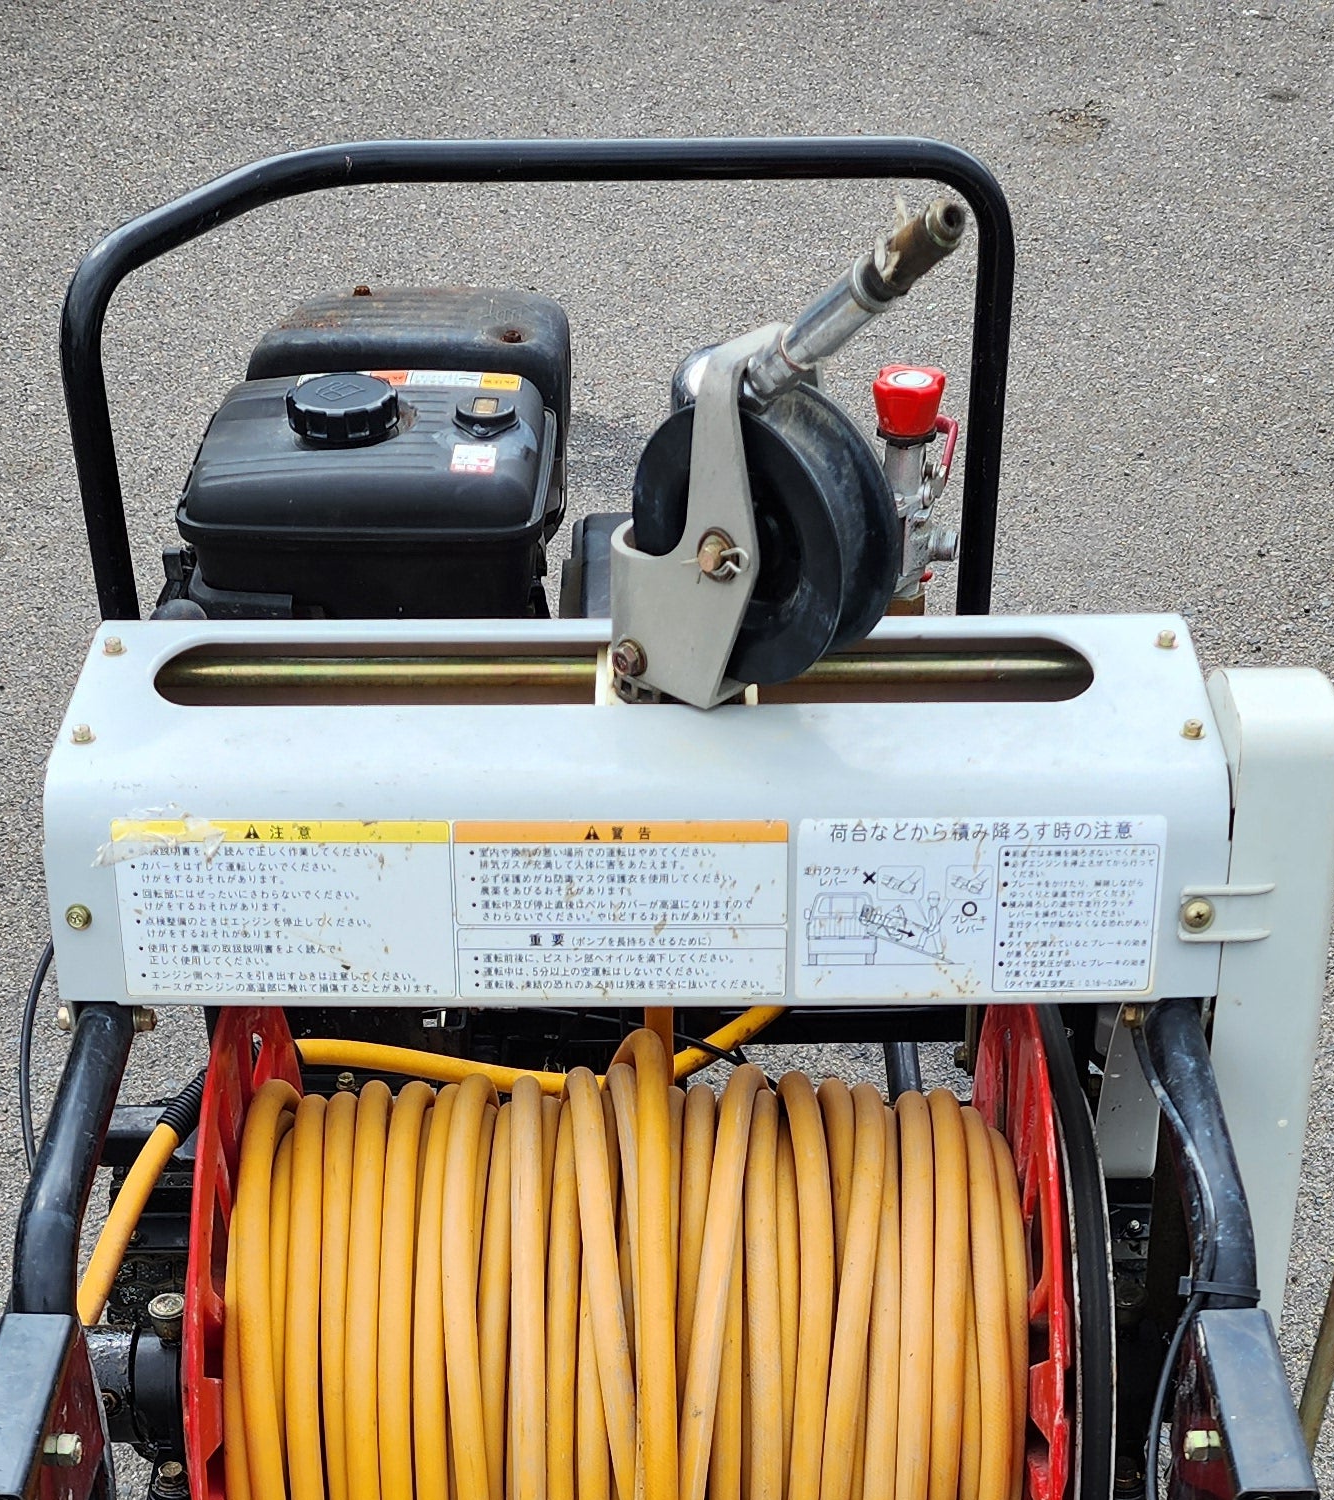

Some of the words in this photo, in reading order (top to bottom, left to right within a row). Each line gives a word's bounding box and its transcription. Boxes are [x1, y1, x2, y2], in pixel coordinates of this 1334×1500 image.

[270, 825, 311, 839] 注意
[612, 826, 651, 840] 警告
[830, 821, 1133, 842] 荷台などから積み降ろす時の注意
[140, 861, 338, 873] カバーをはずして運転しないでください。
[141, 874, 284, 885] けがをするおそれがあります。
[819, 877, 848, 887] レバー
[143, 889, 359, 900] 回転部にはぜったいにさわらないでください。
[144, 902, 286, 912] けがをするおそれがあります。
[145, 916, 372, 928] 点検整備のときはエンジンを停止してください。
[147, 929, 288, 940] けがをするおそれがあります。
[956, 925, 984, 934] レバー
[530, 934, 564, 946] 重要
[150, 955, 269, 966] 正しく使用してください。
